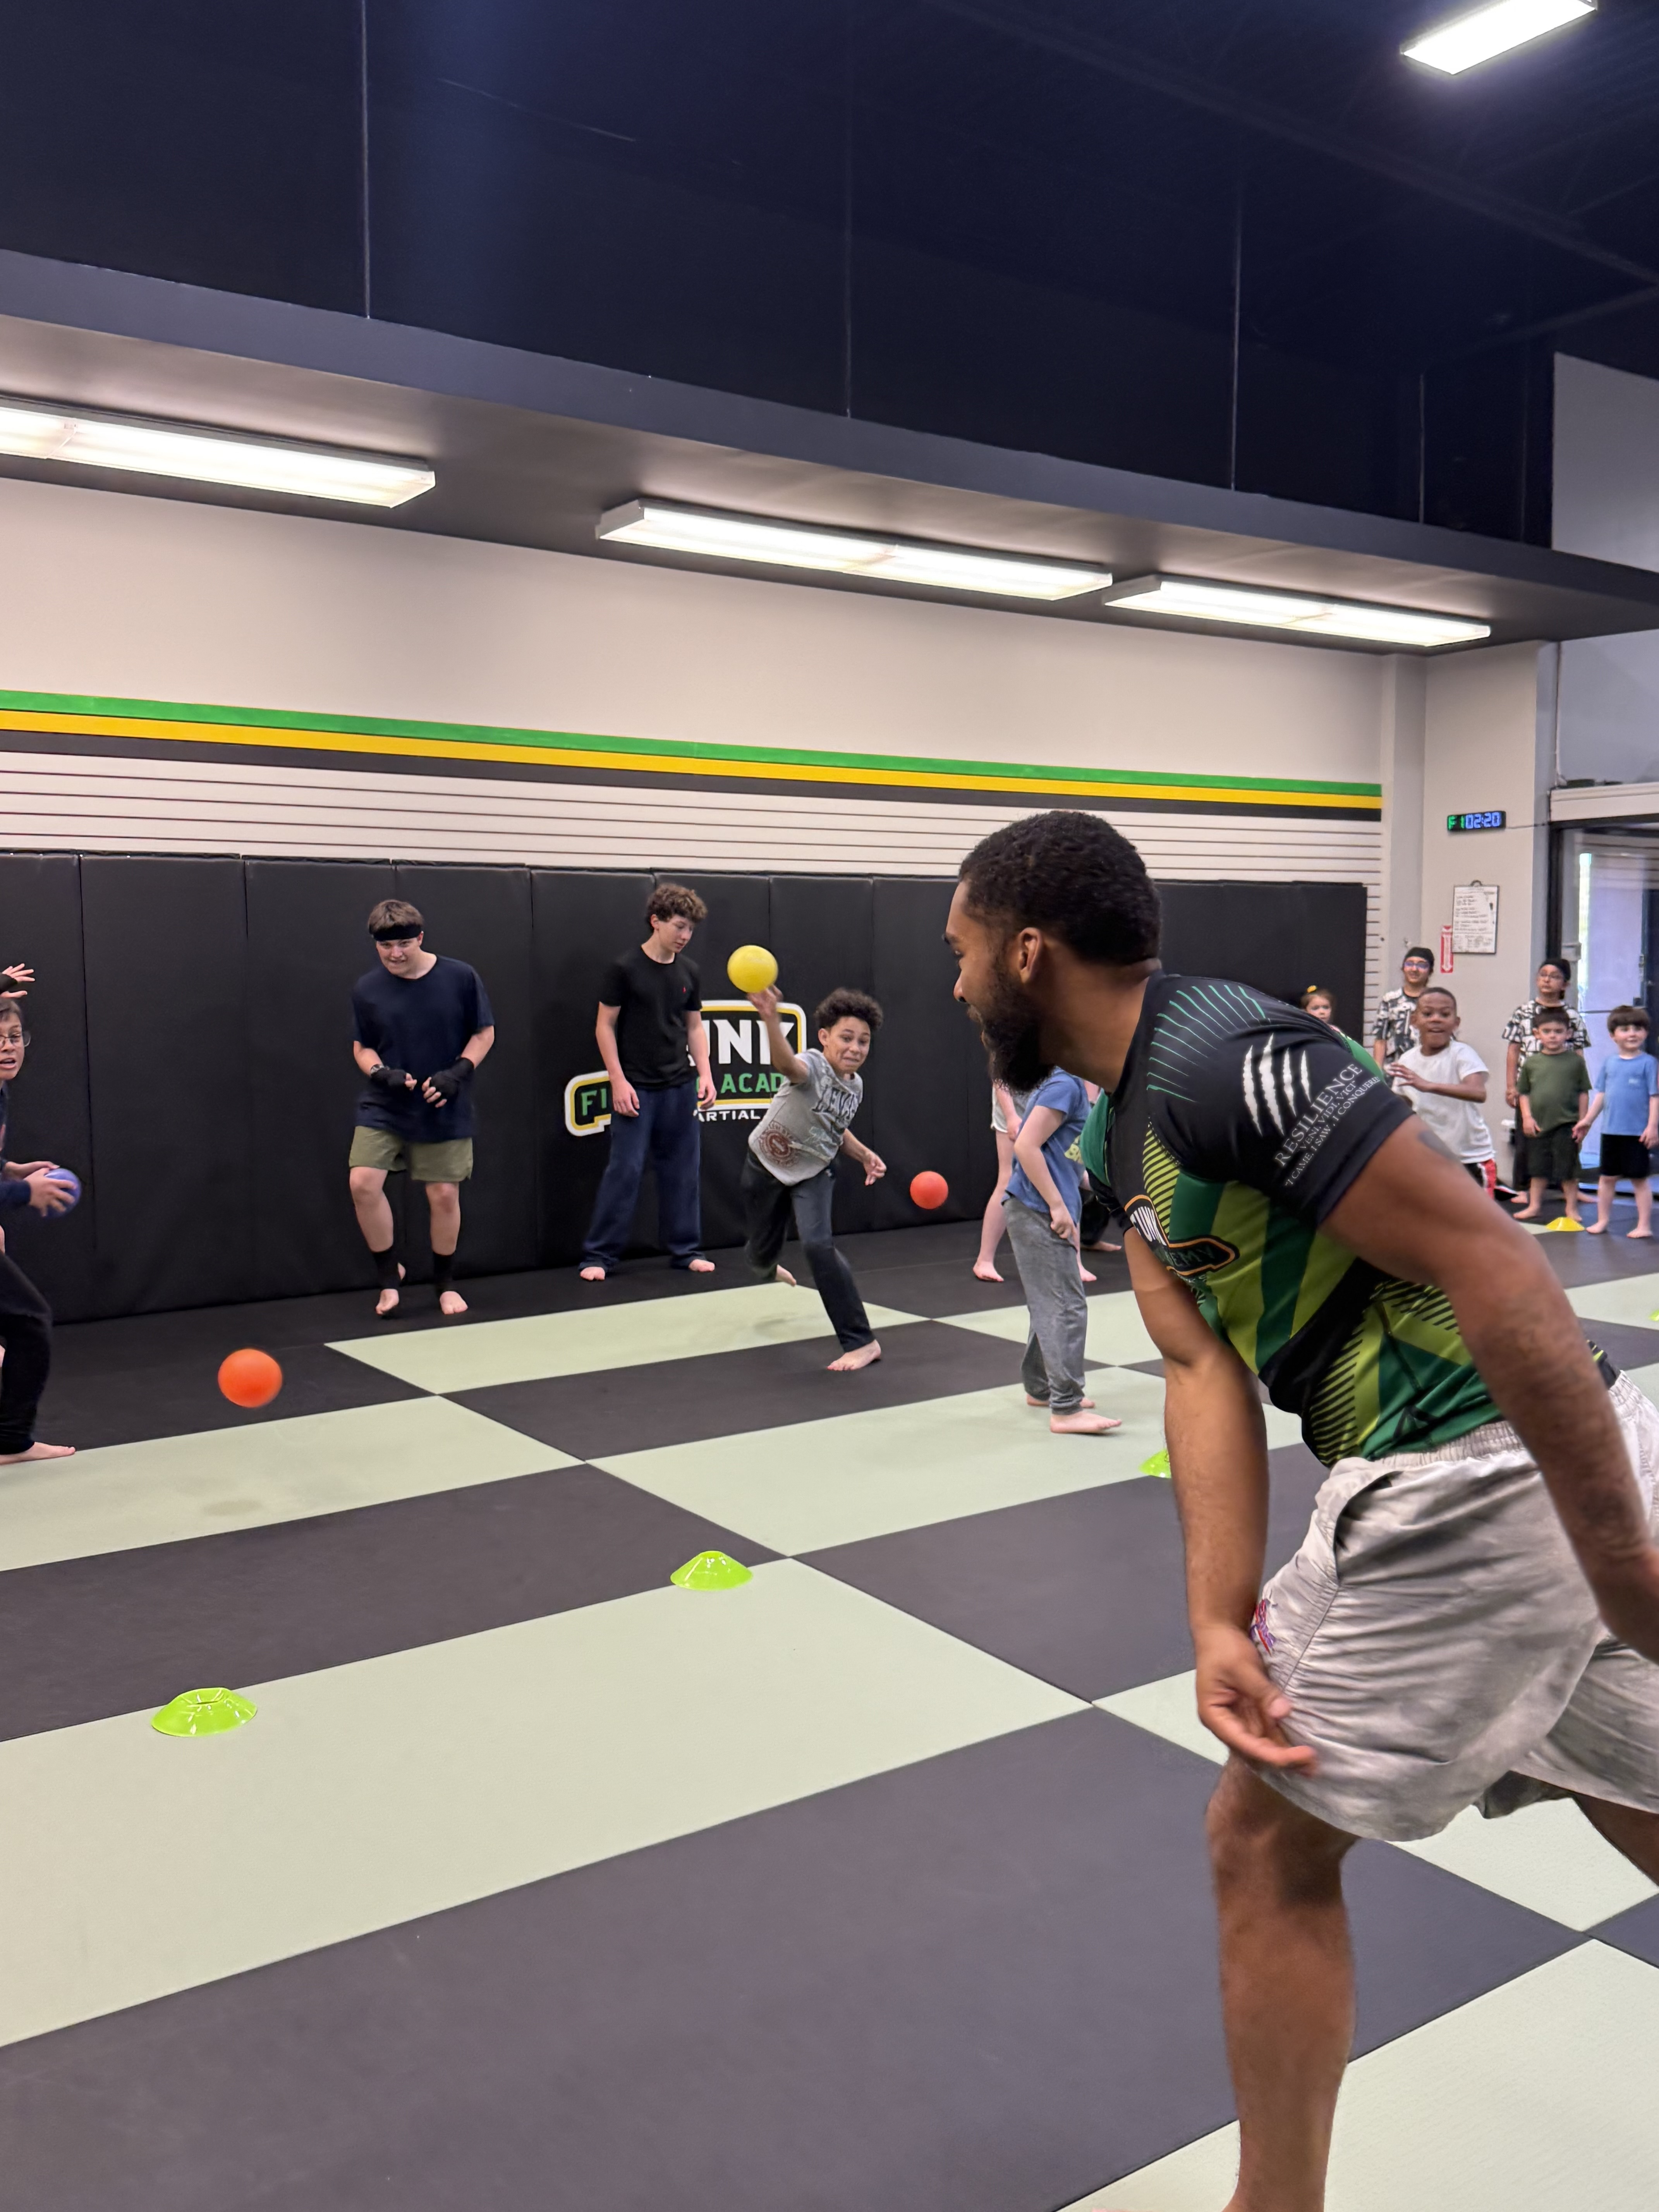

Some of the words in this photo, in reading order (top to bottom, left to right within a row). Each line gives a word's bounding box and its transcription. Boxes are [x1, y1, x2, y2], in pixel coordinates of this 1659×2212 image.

[1465, 812, 1500, 829] 02:20
[693, 1109, 761, 1122] ARTIAL
[1275, 1064, 1362, 1166] RESILIENCE
